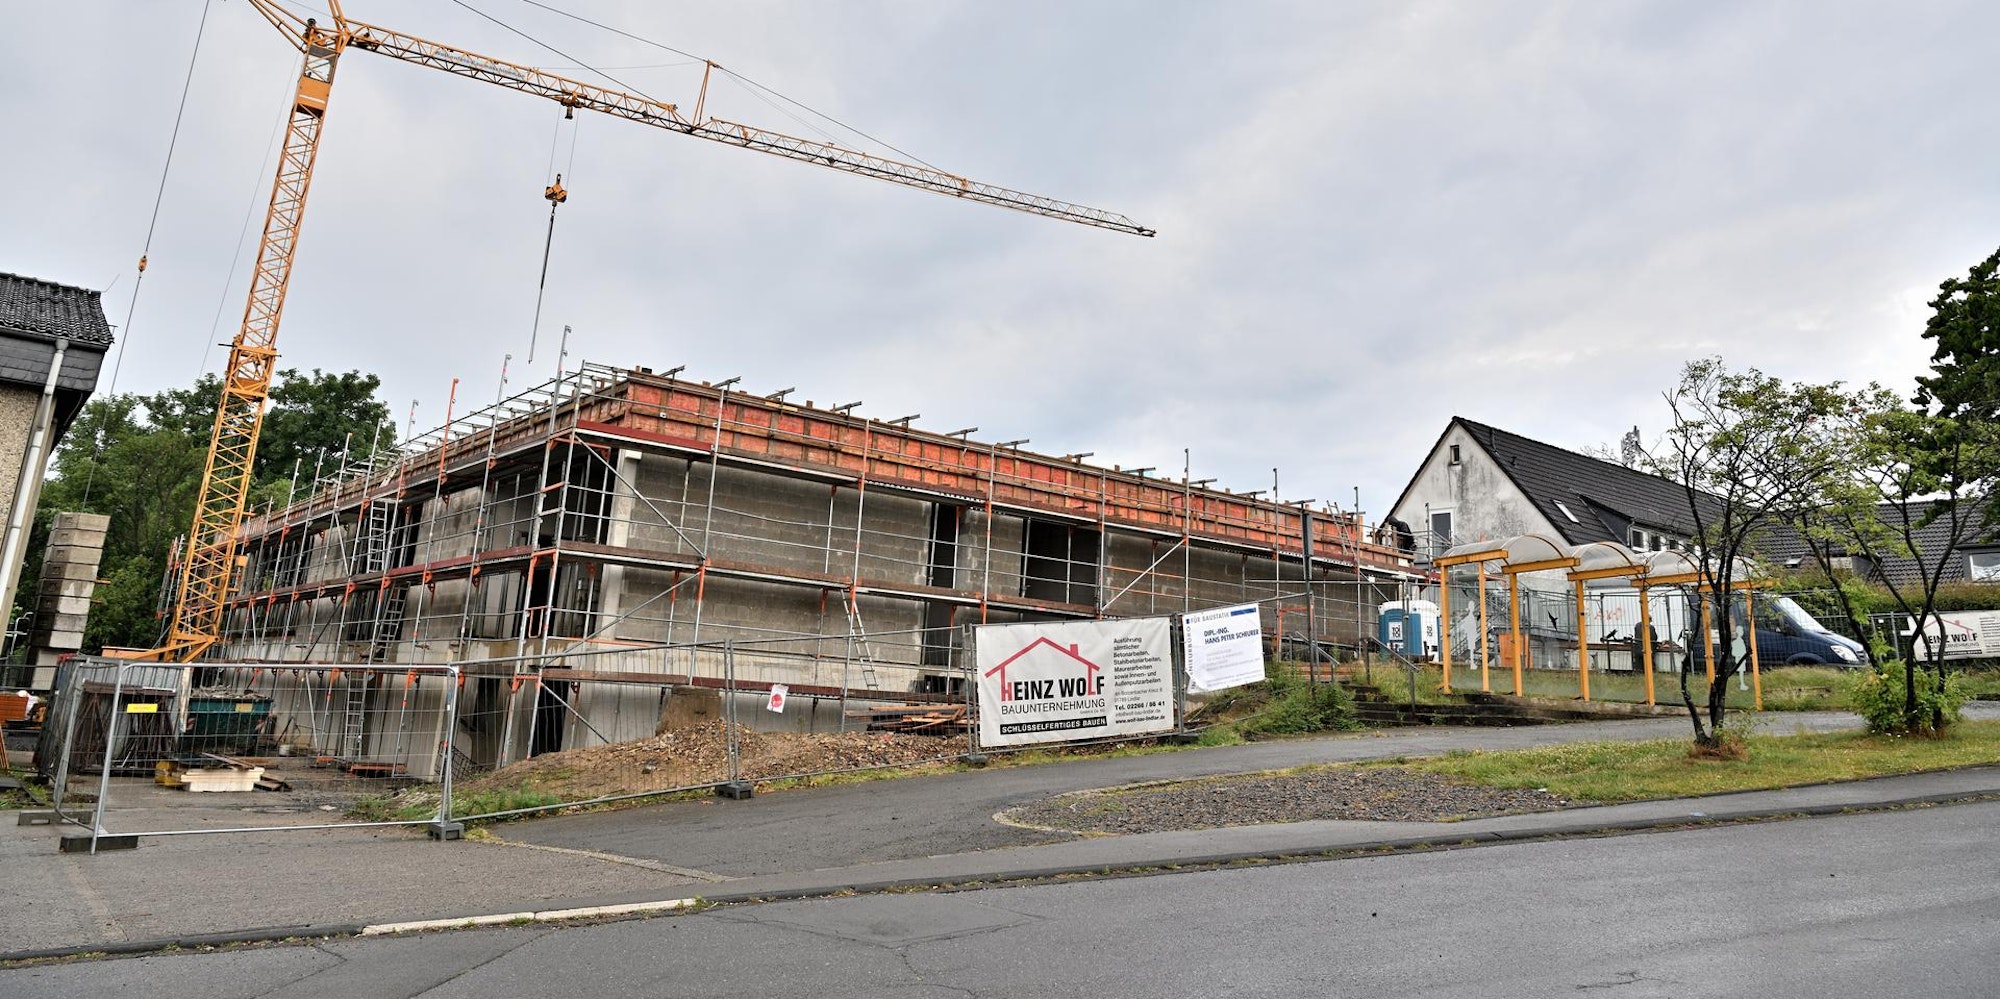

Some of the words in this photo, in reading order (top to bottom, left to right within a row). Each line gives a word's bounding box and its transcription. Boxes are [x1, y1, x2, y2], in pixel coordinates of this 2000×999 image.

[1204, 636, 1221, 645] HANS
[1221, 633, 1235, 642] PETER
[1235, 628, 1259, 640] SCHEURER
[1951, 632, 1978, 643] WOLF
[1001, 679, 1054, 702] HEINZ
[1058, 675, 1105, 698] WOLF
[1001, 698, 1106, 715] BAUUNTERNEHMUNG
[1001, 721, 1081, 734] SCHLÜSSELFERTIGES
[1082, 718, 1106, 727] BAUEN
